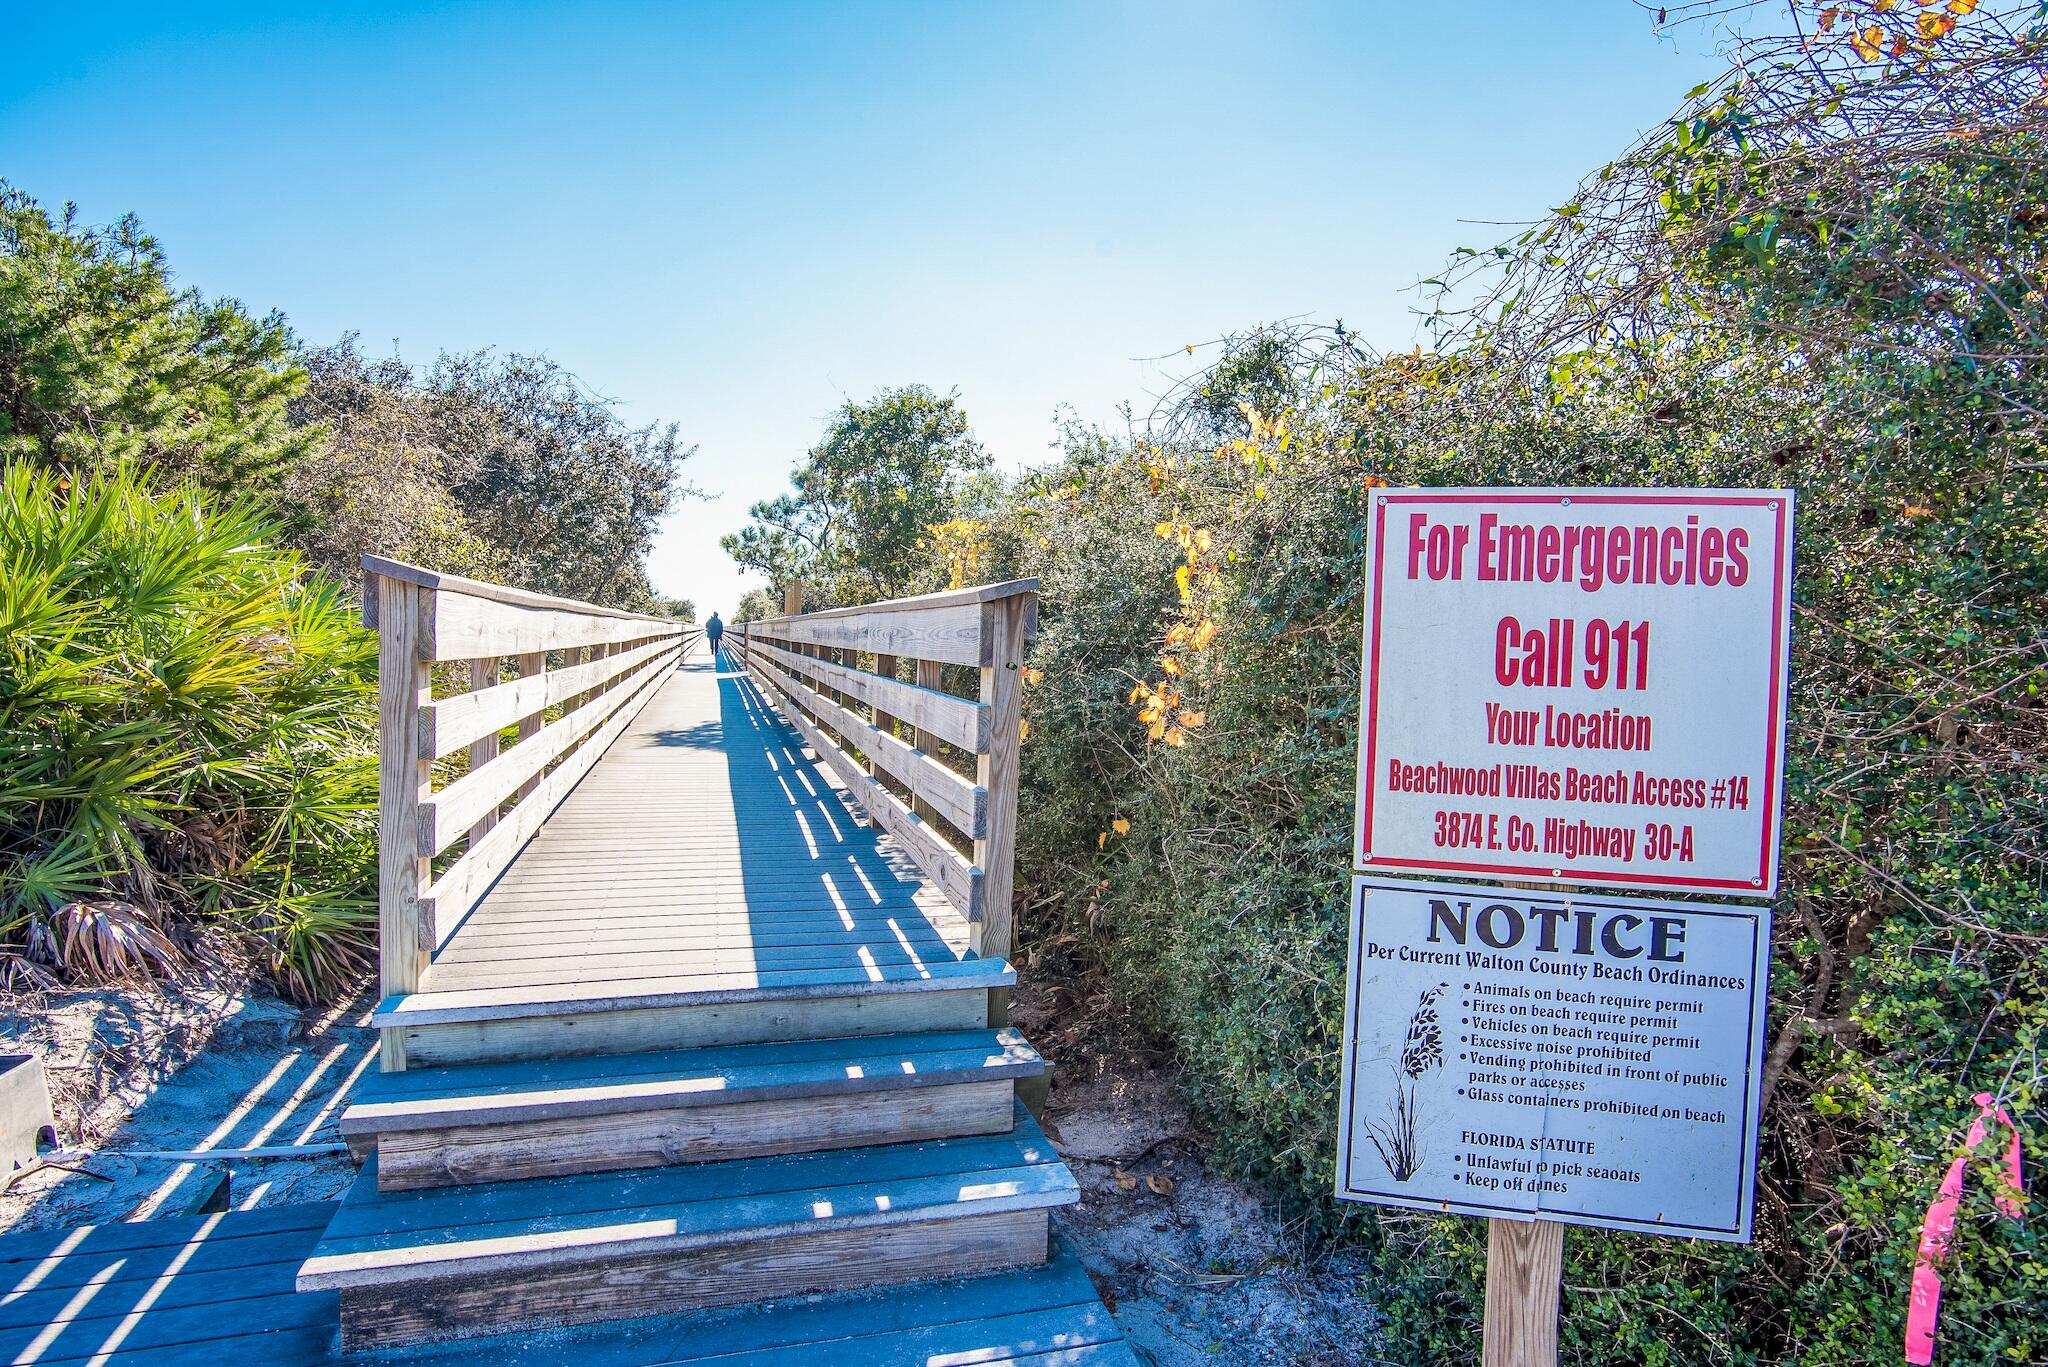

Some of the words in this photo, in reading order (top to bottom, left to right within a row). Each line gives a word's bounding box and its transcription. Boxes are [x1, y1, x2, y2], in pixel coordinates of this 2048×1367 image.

[1408, 513, 1469, 581] For
[1477, 513, 1749, 592] Emergencies
[1495, 615, 1574, 688] Call
[1584, 618, 1651, 690] 911
[1485, 703, 1541, 746] Your
[1545, 705, 1652, 751] Location
[1389, 759, 1501, 797] Beachwood
[1505, 764, 1561, 800] Villas
[1565, 768, 1628, 804] Beach
[1632, 770, 1707, 808] Access
[1710, 776, 1749, 810] #14
[1434, 811, 1482, 849] 3874
[1488, 814, 1502, 850] E.
[1507, 816, 1539, 852] Co.
[1544, 817, 1635, 862] Highway
[1644, 823, 1694, 862] 30-A
[1427, 900, 1688, 962] NOTICE
[1368, 943, 1395, 960] Per
[1399, 946, 1461, 966] Current
[1466, 952, 1524, 971] Walton
[1529, 957, 1588, 980] County
[1593, 963, 1643, 982] Beach
[1648, 967, 1745, 990] Ordinances
[1473, 1000, 1505, 1013] Fires
[1510, 1005, 1526, 1015] on
[1532, 1005, 1570, 1019] beach
[1575, 1011, 1626, 1024] require
[1630, 1016, 1678, 1029] permit
[1474, 982, 1530, 998] Animals
[1535, 989, 1551, 1000] on
[1556, 989, 1595, 1003] beach
[1600, 995, 1651, 1009] require
[1655, 1000, 1703, 1013] permit
[1471, 1034, 1532, 1051] Excessive
[1537, 1042, 1572, 1054] noise
[1577, 1046, 1651, 1062] prohibited
[1472, 1016, 1527, 1033] Vehicles
[1532, 1025, 1548, 1034] on
[1554, 1024, 1592, 1039] beach
[1597, 1030, 1648, 1044] require
[1652, 1035, 1700, 1049] permit
[1469, 1072, 1506, 1084] parks
[1511, 1076, 1526, 1086] or
[1530, 1078, 1585, 1091] accesses
[1470, 1052, 1525, 1071] Vending
[1530, 1060, 1602, 1075] prohibited
[1607, 1065, 1620, 1077] in
[1625, 1066, 1661, 1080] front
[1665, 1070, 1680, 1082] of
[1683, 1073, 1728, 1087] public
[1468, 1087, 1503, 1102] Glass
[1508, 1094, 1579, 1108] containers
[1584, 1099, 1658, 1117] prohibited
[1663, 1108, 1680, 1119] on
[1685, 1108, 1726, 1123] beach
[1461, 1131, 1525, 1150] FLORIDA
[1530, 1137, 1595, 1155] STATUTE
[1465, 1172, 1499, 1191] Keep
[1503, 1177, 1524, 1191] off
[1527, 1178, 1568, 1193] dunes
[1467, 1153, 1531, 1174] Unlawful
[1536, 1162, 1548, 1174] to
[1552, 1161, 1583, 1177] pick
[1587, 1166, 1641, 1183] seaoats
